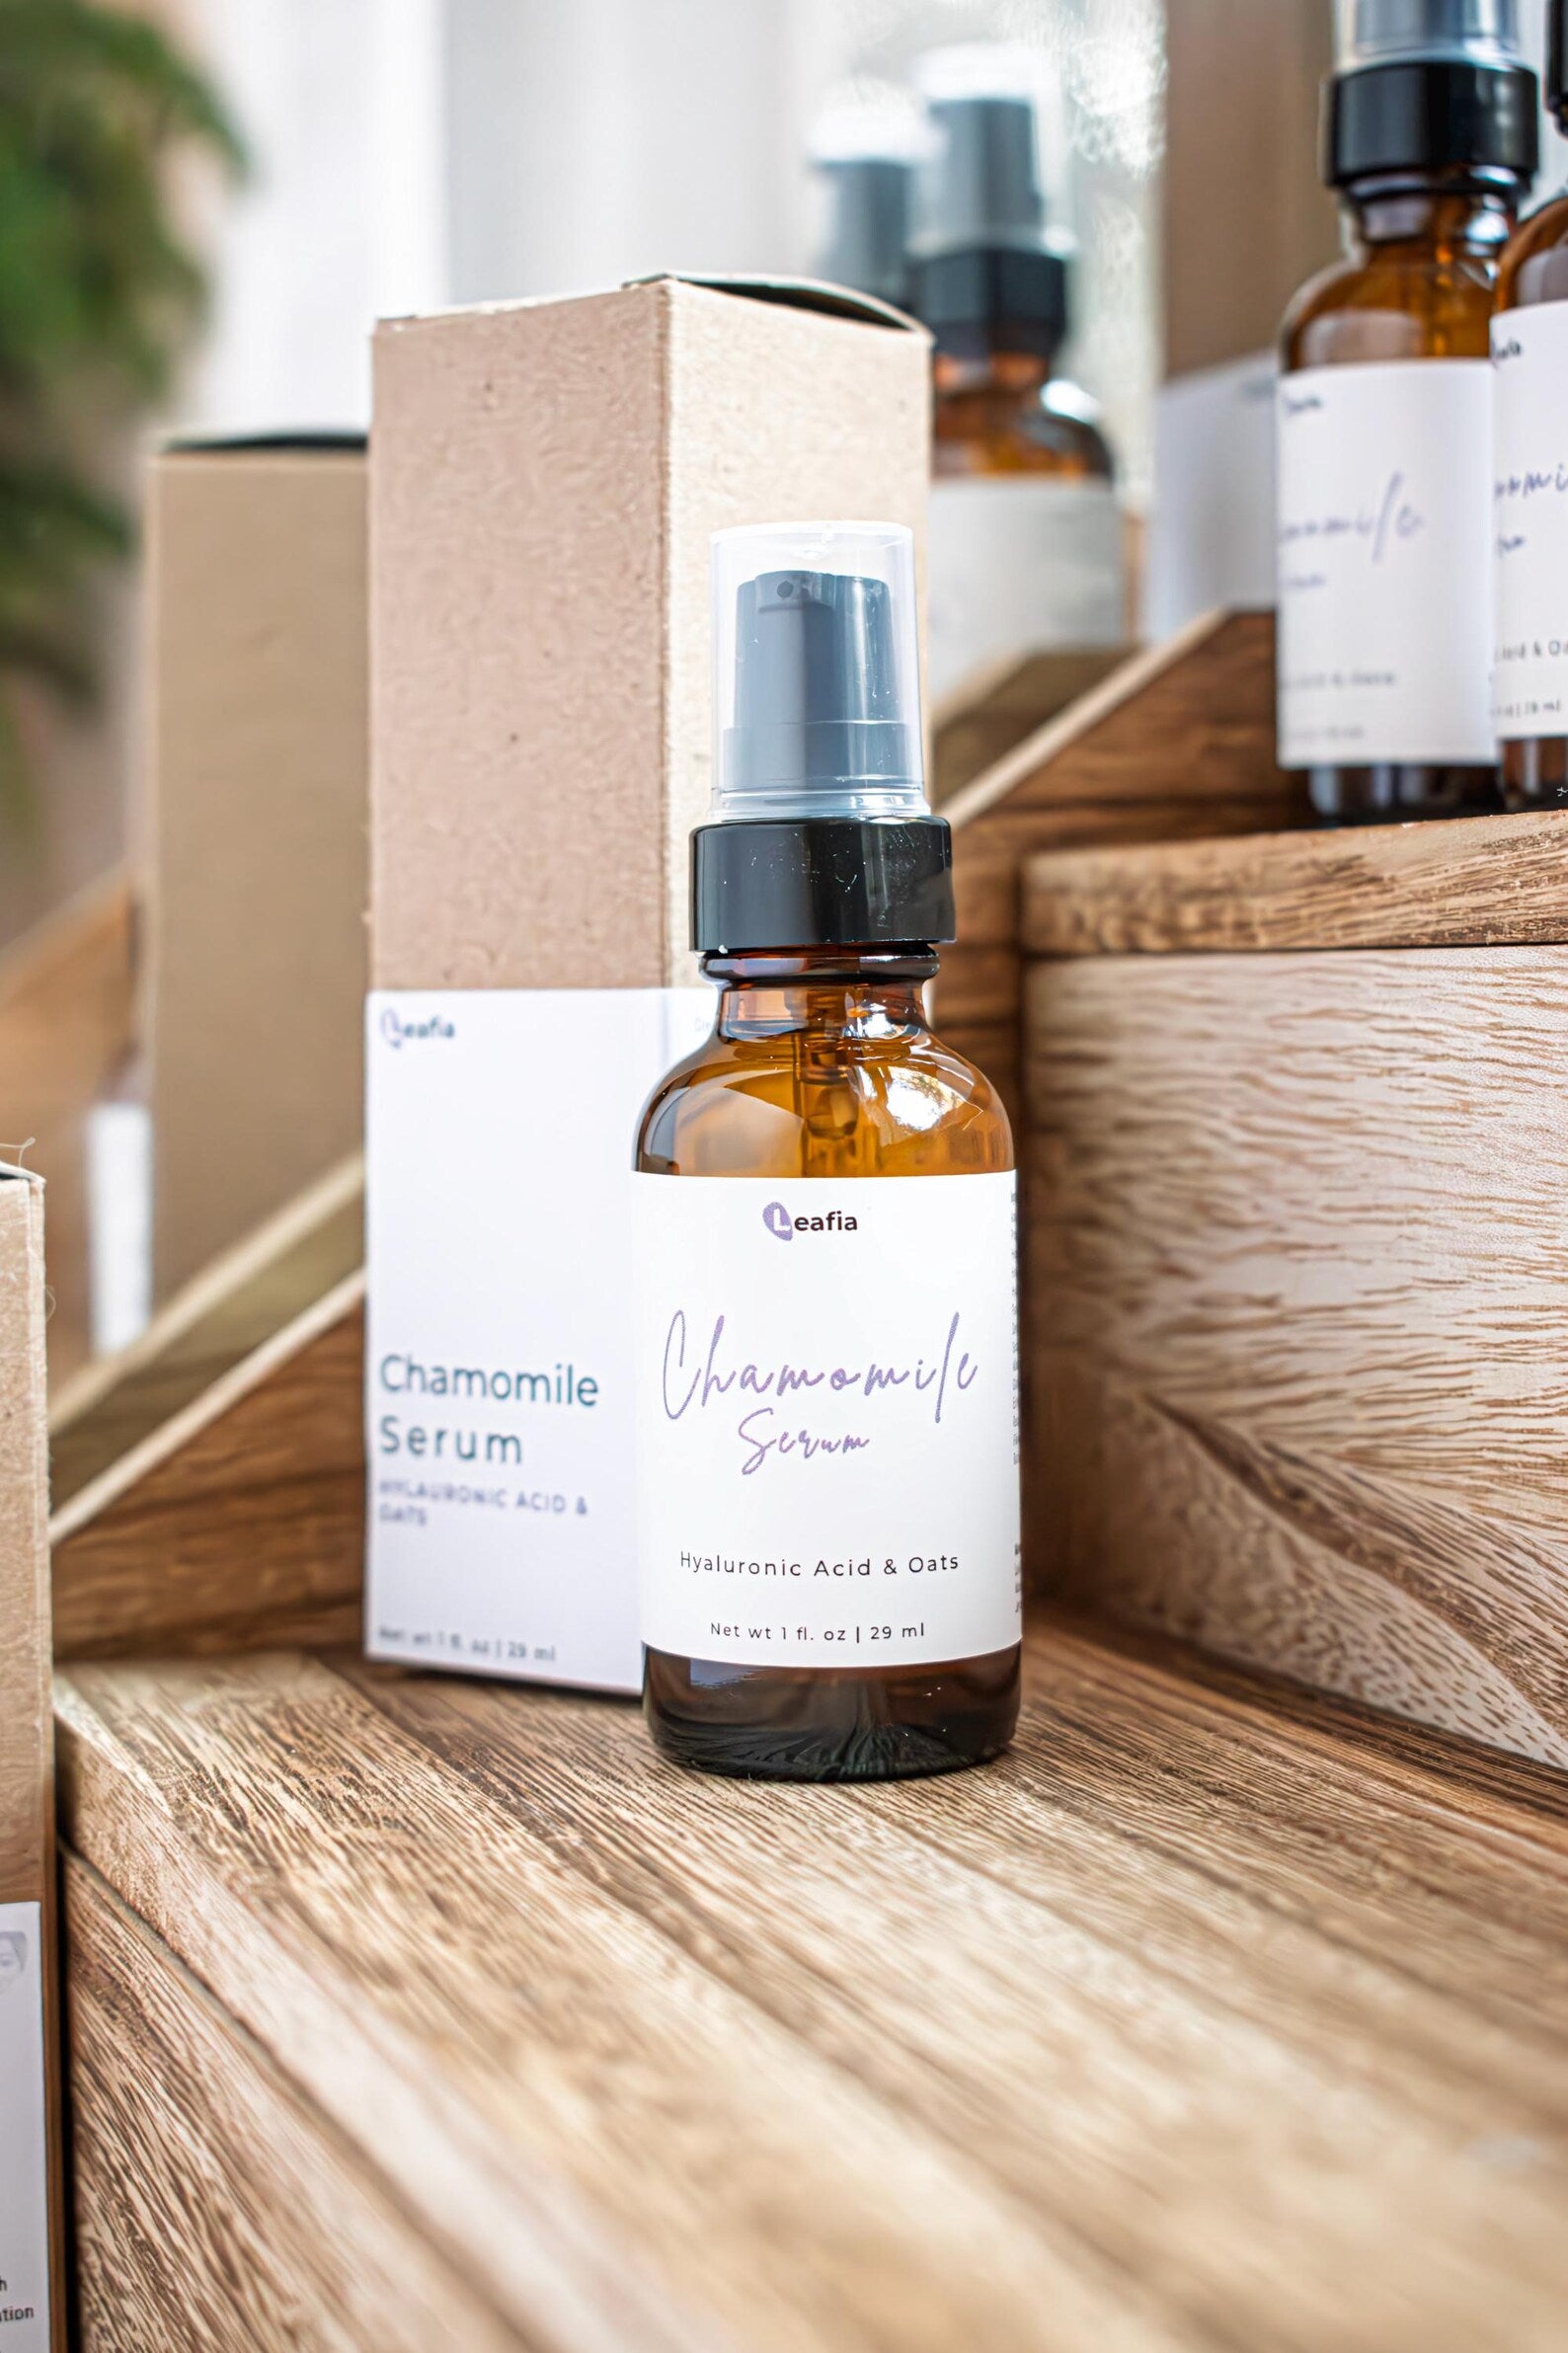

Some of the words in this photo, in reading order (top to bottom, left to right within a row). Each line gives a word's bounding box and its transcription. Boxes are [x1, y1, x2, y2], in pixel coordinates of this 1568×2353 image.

[379, 1008, 455, 1050] eafia
[762, 1202, 858, 1241] Leafia
[380, 1354, 598, 1406] Chamomile
[663, 1309, 979, 1424] Chamomile
[380, 1415, 522, 1463] Serum
[738, 1407, 871, 1475] Serum
[516, 1491, 567, 1513] ACID
[680, 1550, 802, 1577] Hyaluronic
[814, 1558, 871, 1577] Acid
[883, 1558, 898, 1575] &
[908, 1554, 959, 1573] Oats
[710, 1621, 741, 1637] Net
[747, 1625, 771, 1640] wt
[780, 1626, 787, 1640] 1
[796, 1626, 815, 1641] fl.
[823, 1628, 846, 1641] oz
[870, 1626, 892, 1640] 29
[902, 1622, 924, 1638] ml
[0, 2306, 35, 2322] tion
